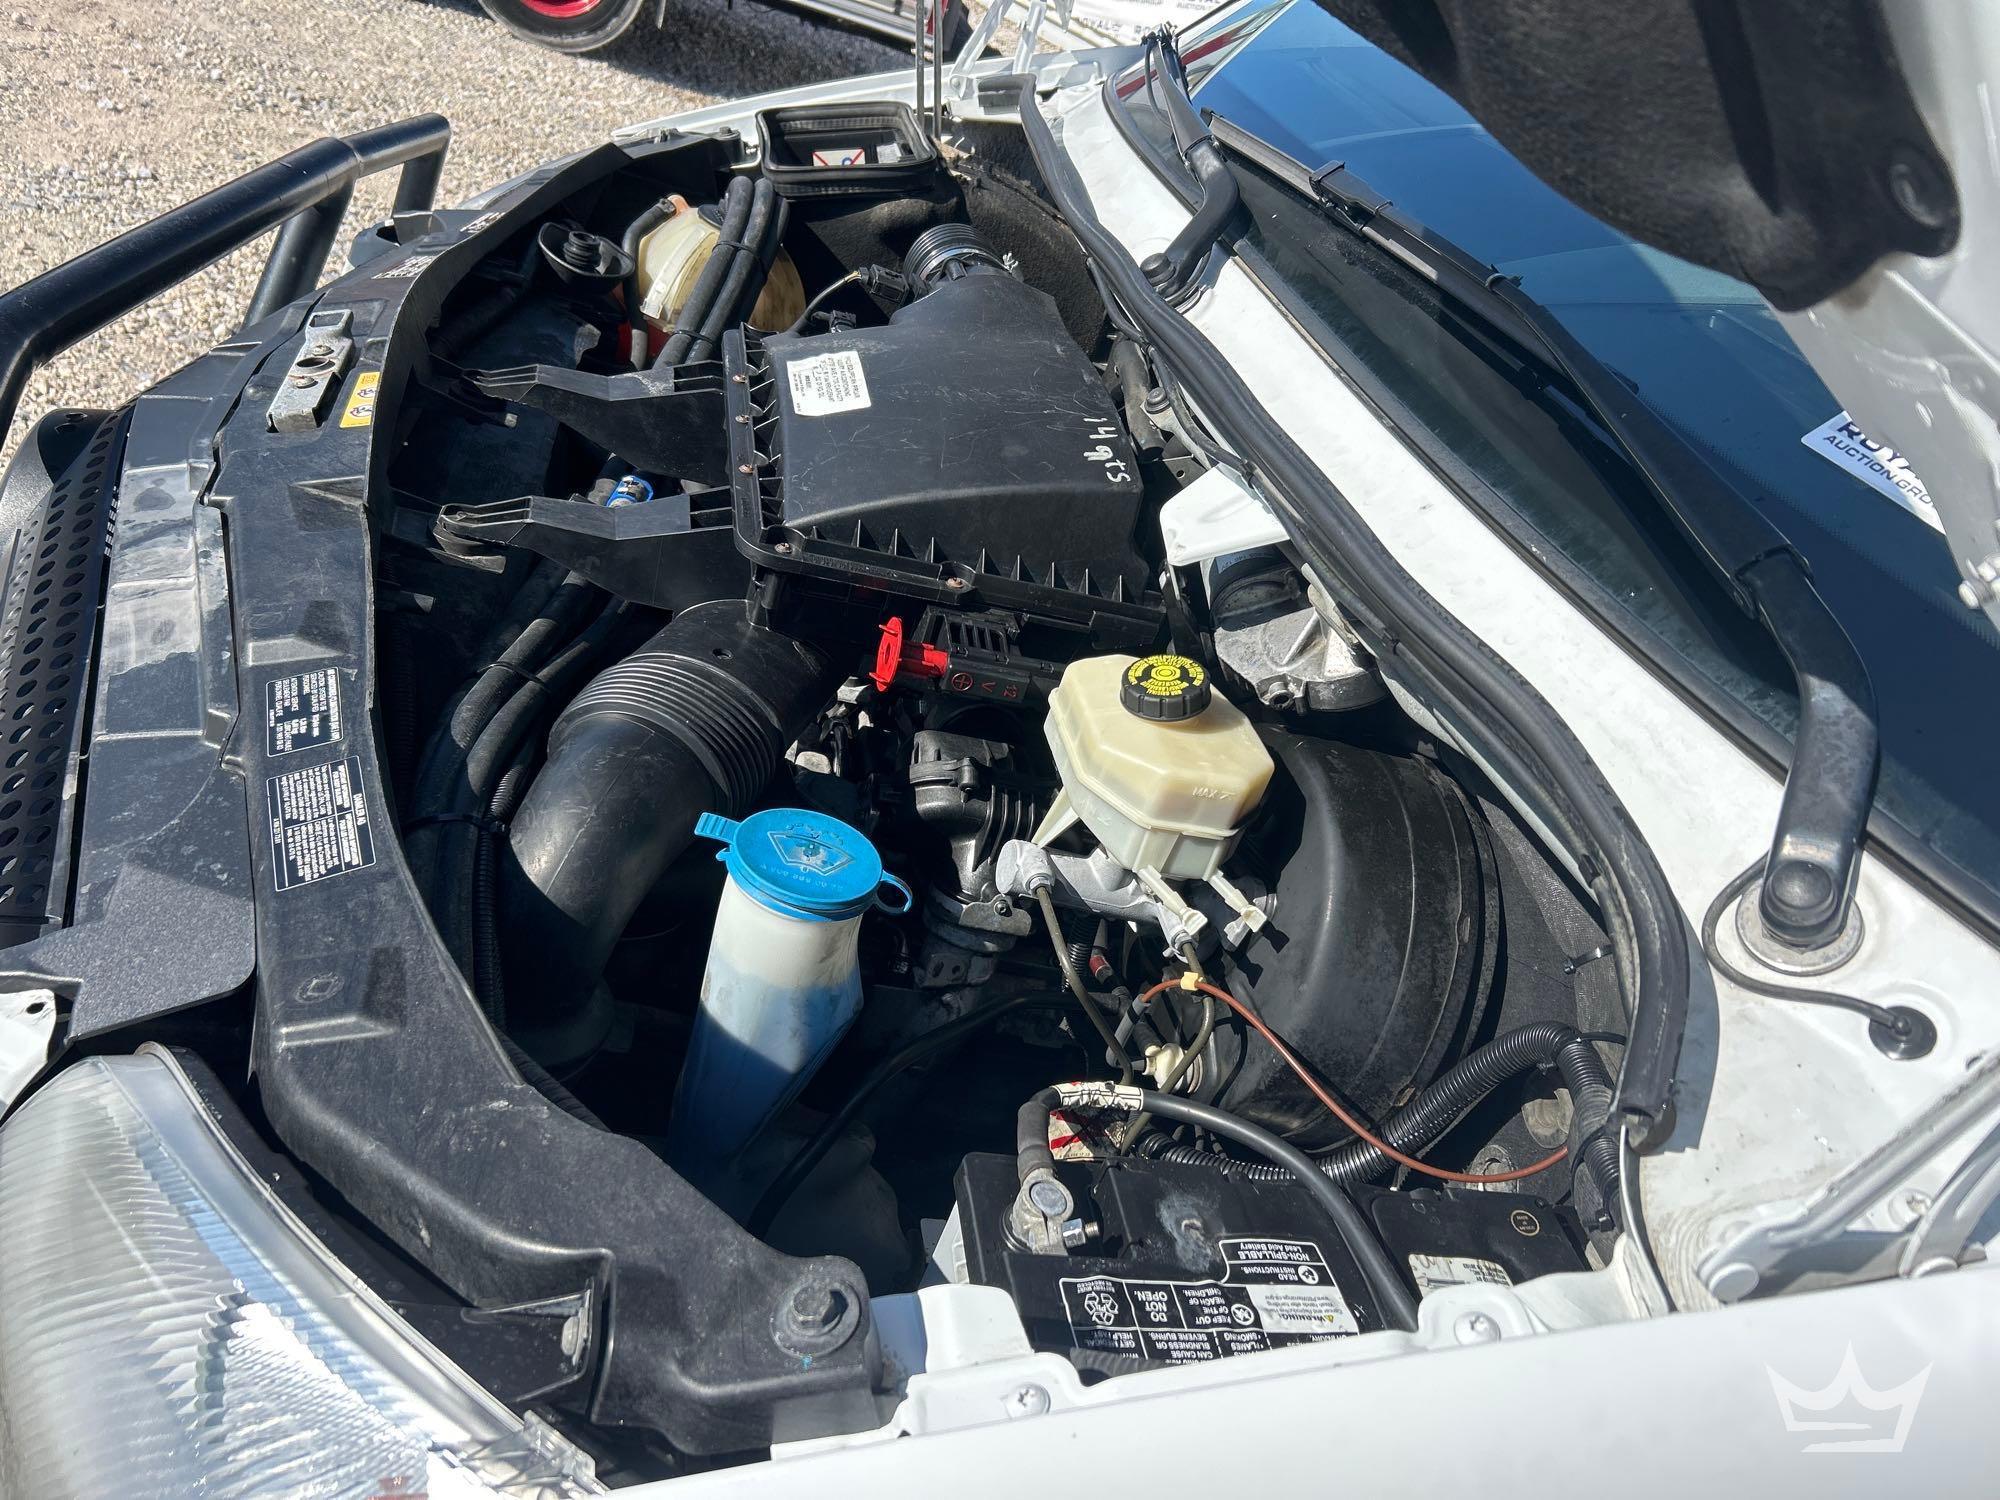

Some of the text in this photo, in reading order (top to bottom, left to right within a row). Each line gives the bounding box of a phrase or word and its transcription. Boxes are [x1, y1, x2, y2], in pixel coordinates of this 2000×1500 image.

[1083, 417, 1119, 439] 14
[1823, 435, 1934, 505] AUCTION GRO
[1240, 1242, 1267, 1251] Battery
[1238, 1250, 1310, 1261] NON-SPILLABLE
[1240, 1266, 1295, 1274] INSTRUCTIONS.
[1278, 1273, 1298, 1281] READ
[1133, 1290, 1168, 1302] OPEN.
[1144, 1301, 1167, 1312] NOT
[1202, 1305, 1229, 1314] OF THE
[1150, 1311, 1168, 1322] DO
[1195, 1316, 1231, 1324] KEEP OUT
[1278, 1313, 1325, 1323] WARNING:
[1112, 1332, 1133, 1340] HELP
[1148, 1332, 1207, 1341] SEVERE BURNS.
[1223, 1332, 1257, 1341] SMOKING
[1120, 1339, 1135, 1348] GET
[1155, 1341, 1211, 1350] BLINDNESS OR
[1170, 1350, 1213, 1359] CAN CAUSE
